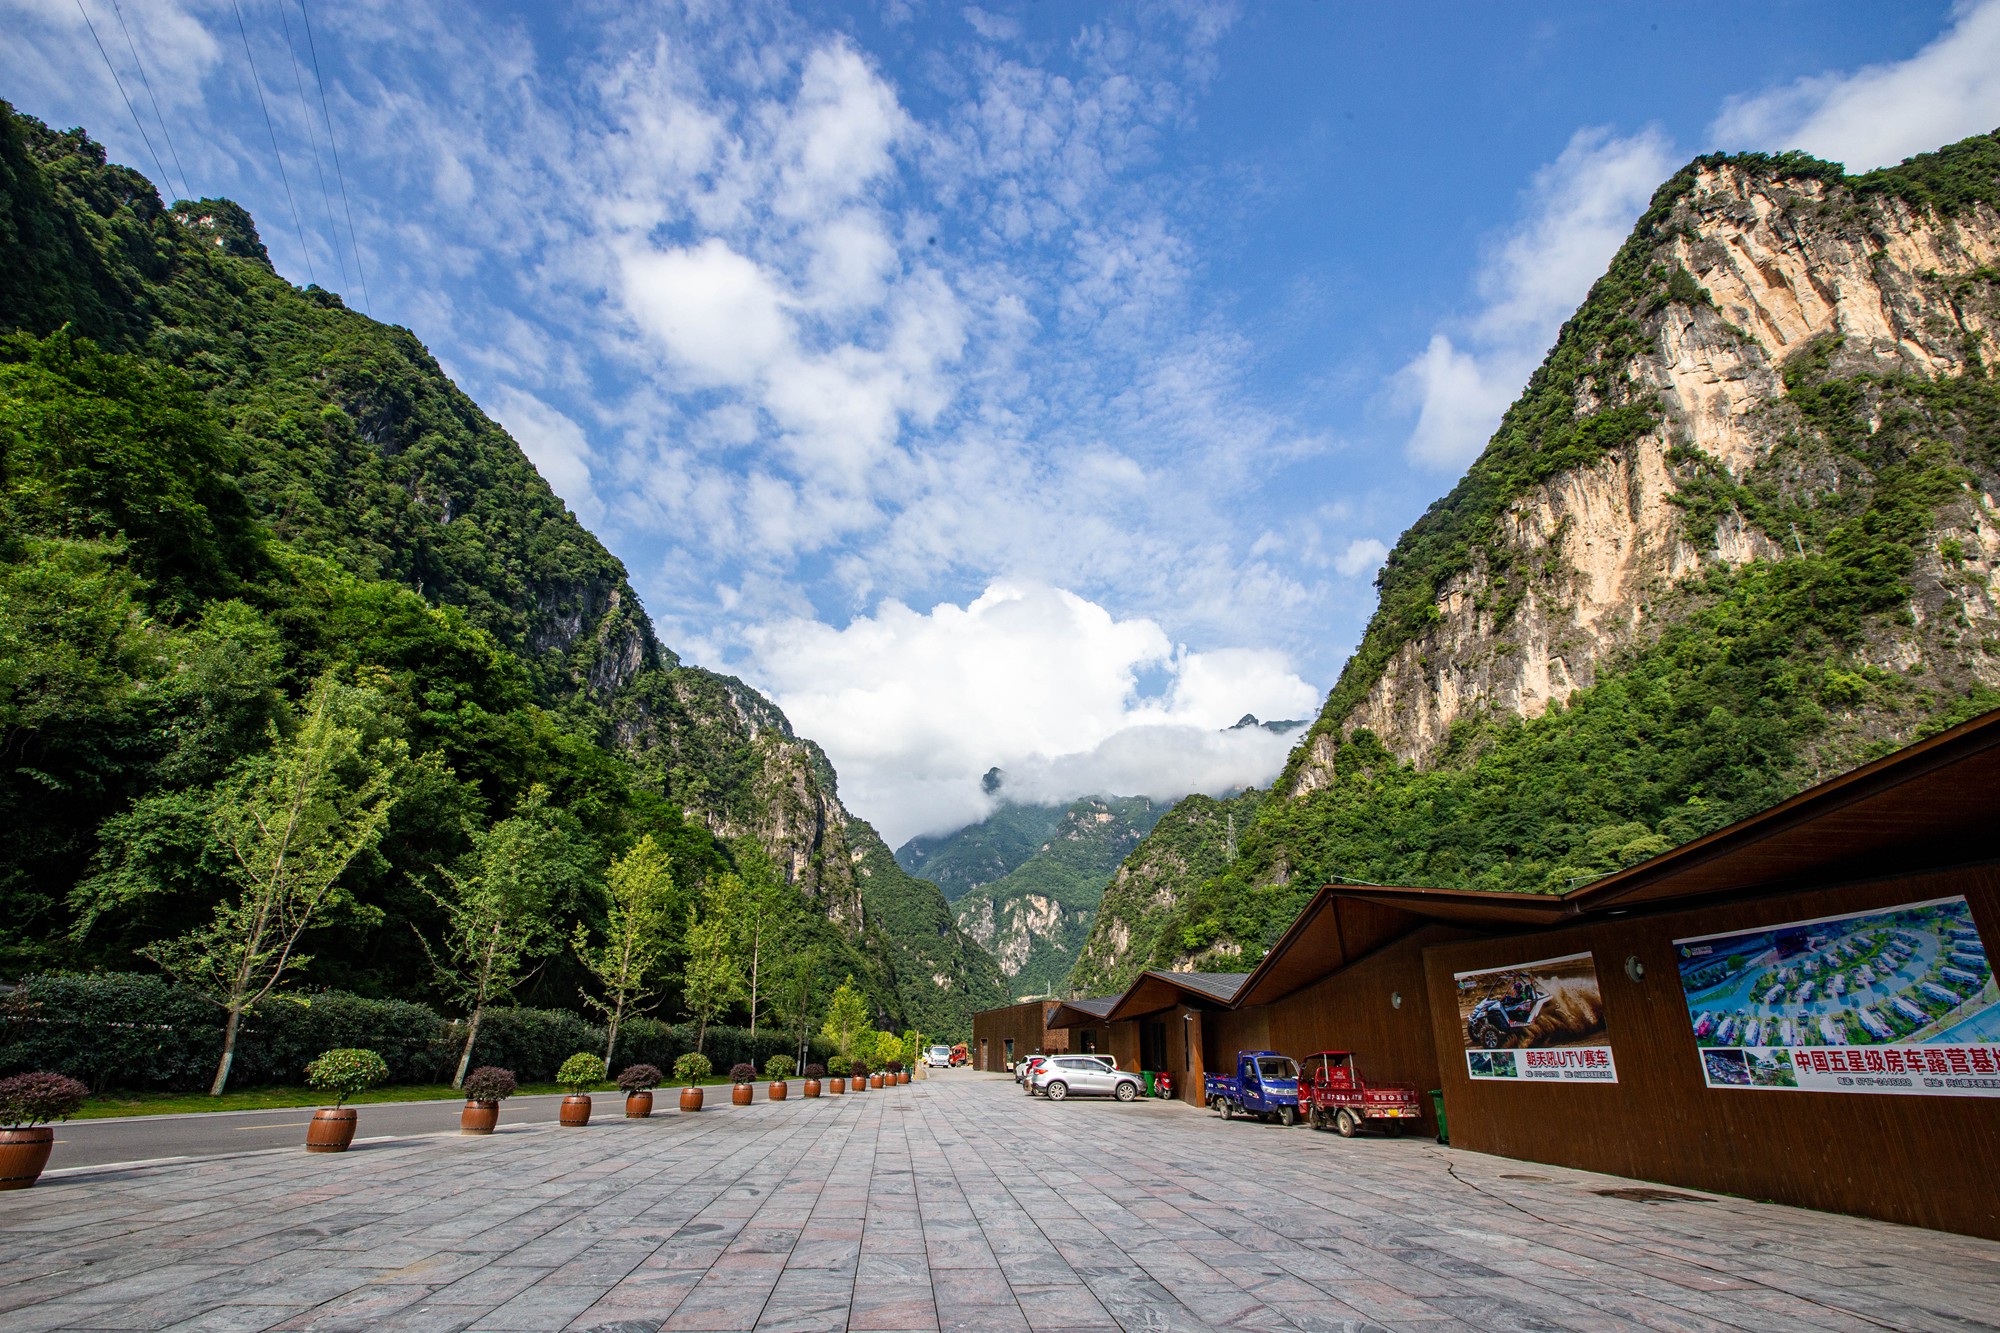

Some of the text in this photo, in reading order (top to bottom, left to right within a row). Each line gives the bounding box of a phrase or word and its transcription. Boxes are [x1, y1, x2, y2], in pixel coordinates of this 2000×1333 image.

[1526, 1050, 1608, 1067] 朝天吼UTV赛车
